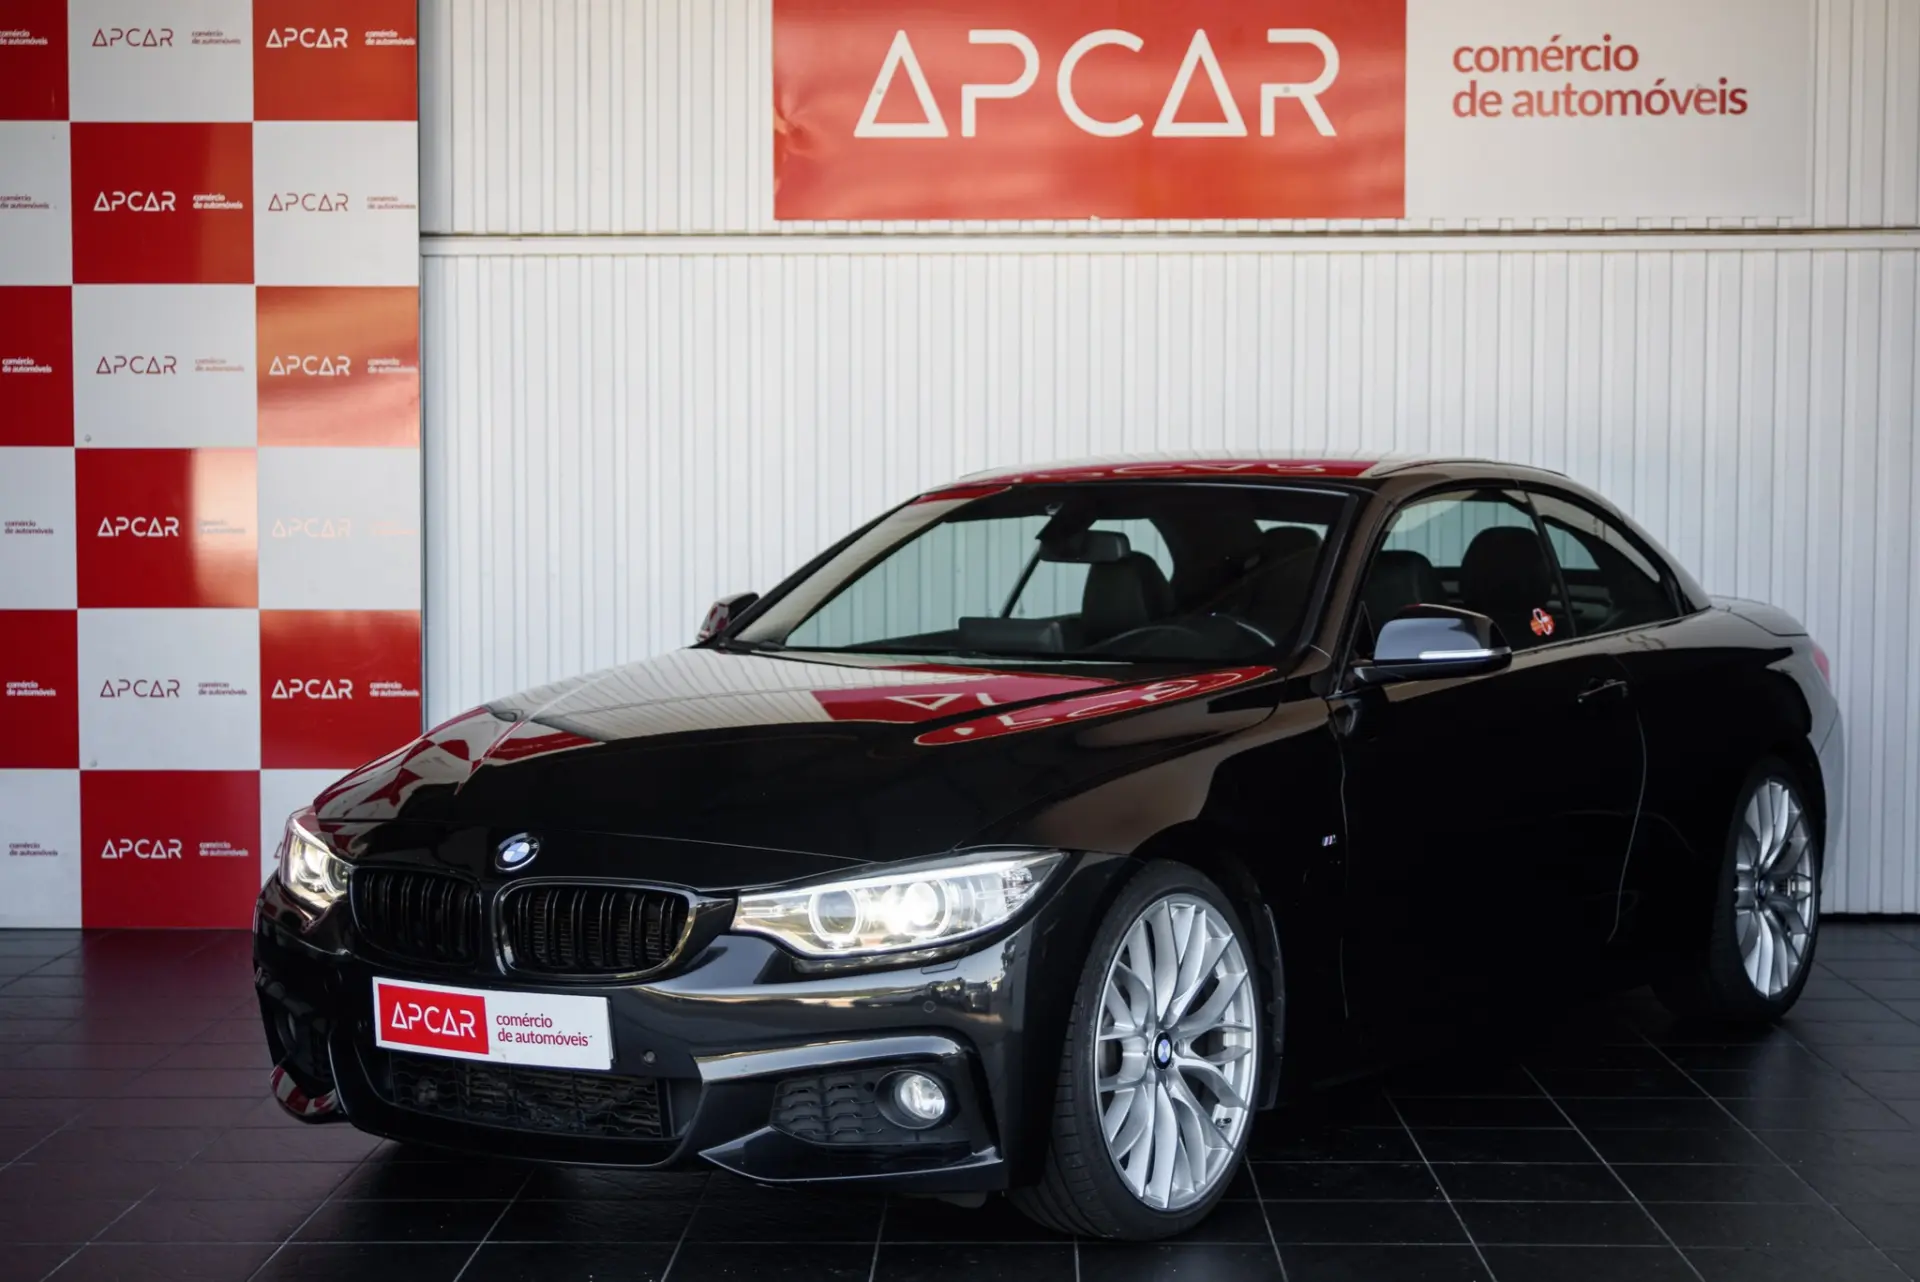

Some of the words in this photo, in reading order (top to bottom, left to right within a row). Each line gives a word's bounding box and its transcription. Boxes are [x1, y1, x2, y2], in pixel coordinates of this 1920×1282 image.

[92, 28, 173, 47] APCAR
[265, 28, 348, 48] APCAR
[1452, 34, 1639, 75] comércio
[853, 28, 1340, 138] APCAR
[1452, 79, 1505, 119] de
[1511, 77, 1748, 119] automóveis
[93, 192, 176, 212] APCAR
[268, 193, 349, 212] APCAR
[96, 356, 177, 374] APCAR
[268, 355, 351, 376] APCAR
[97, 517, 180, 537] APCAR
[100, 679, 180, 698] APCAR
[271, 679, 353, 699] APCAR
[101, 838, 182, 859] APCAR
[391, 1001, 476, 1038] APCAR
[496, 1013, 552, 1029] comércio
[498, 1028, 512, 1042] de
[515, 1029, 588, 1047] automóveis
